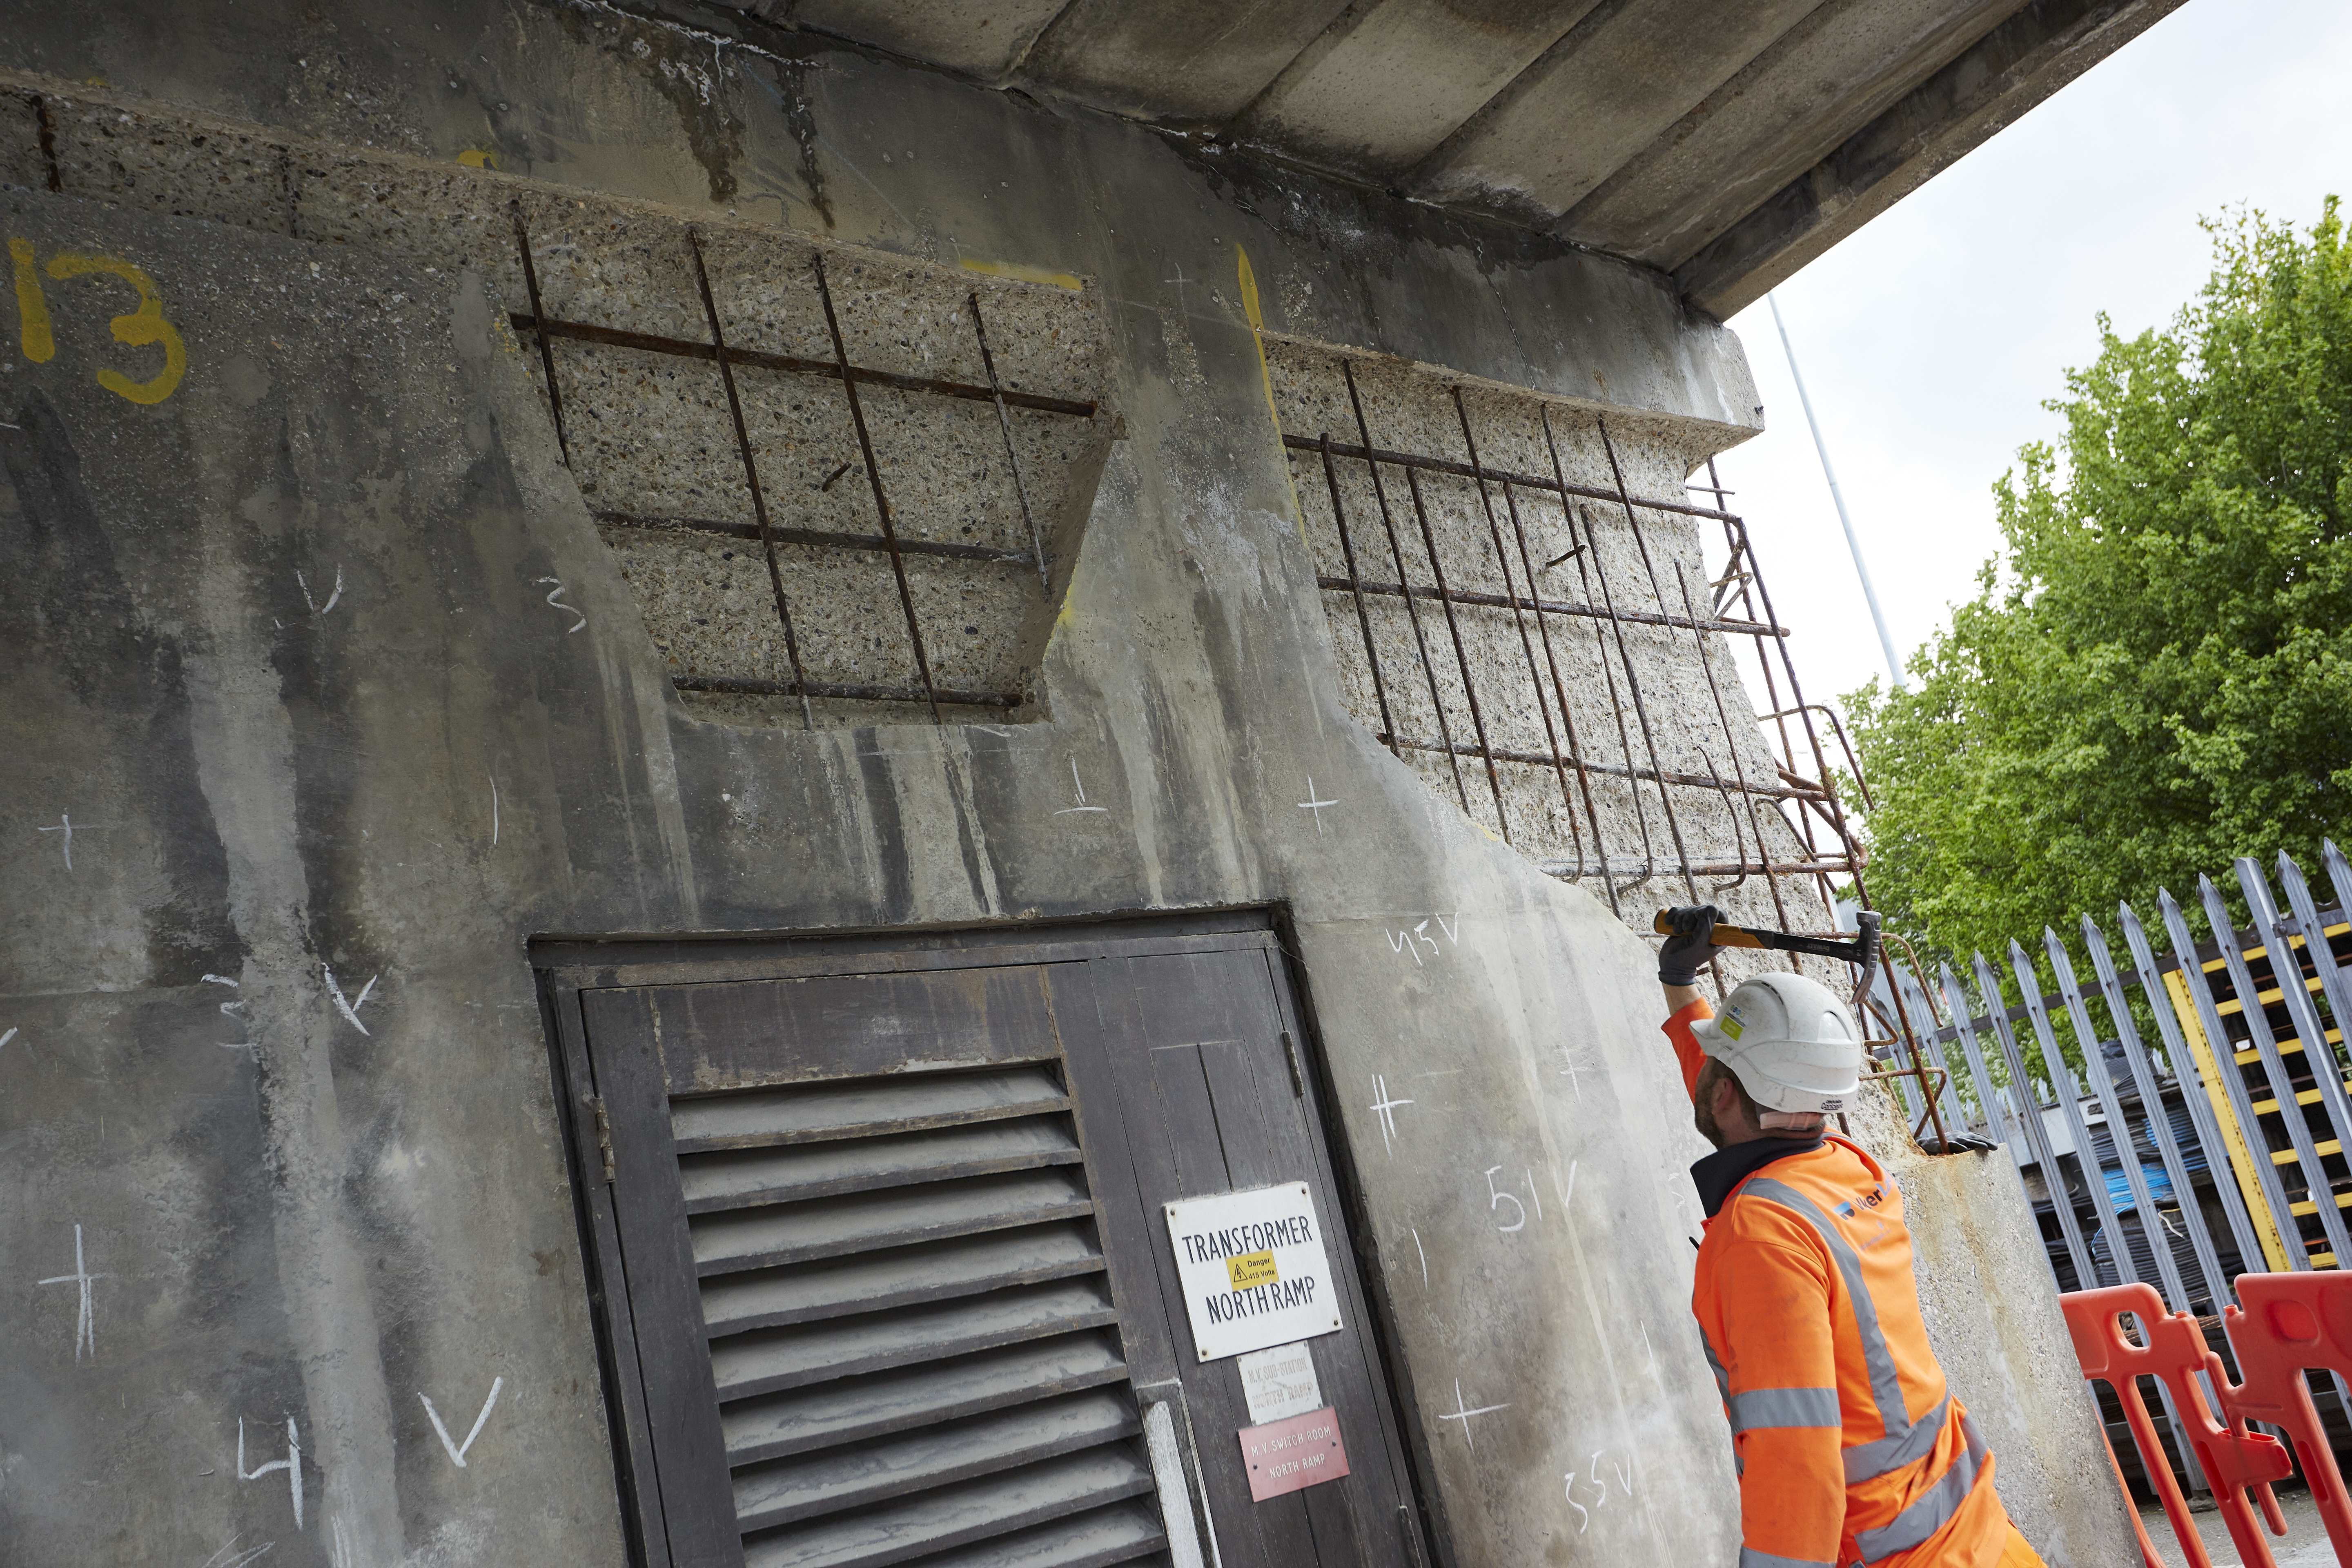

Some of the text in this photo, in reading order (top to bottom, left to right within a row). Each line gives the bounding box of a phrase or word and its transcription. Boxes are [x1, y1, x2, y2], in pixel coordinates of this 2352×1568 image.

[7, 236, 187, 405] 13
[1182, 1216, 1313, 1264] TRANSFORMER
[1247, 1258, 1270, 1267] Danger
[1206, 1276, 1315, 1324] NORTH RAMP
[1263, 1357, 1307, 1380] SUB-STATION
[1252, 1381, 1314, 1409] NORTH RAMP
[1271, 1432, 1304, 1452] SWITCH
[1306, 1425, 1331, 1442] ROOM
[1269, 1453, 1325, 1479] NORTH RAMP
